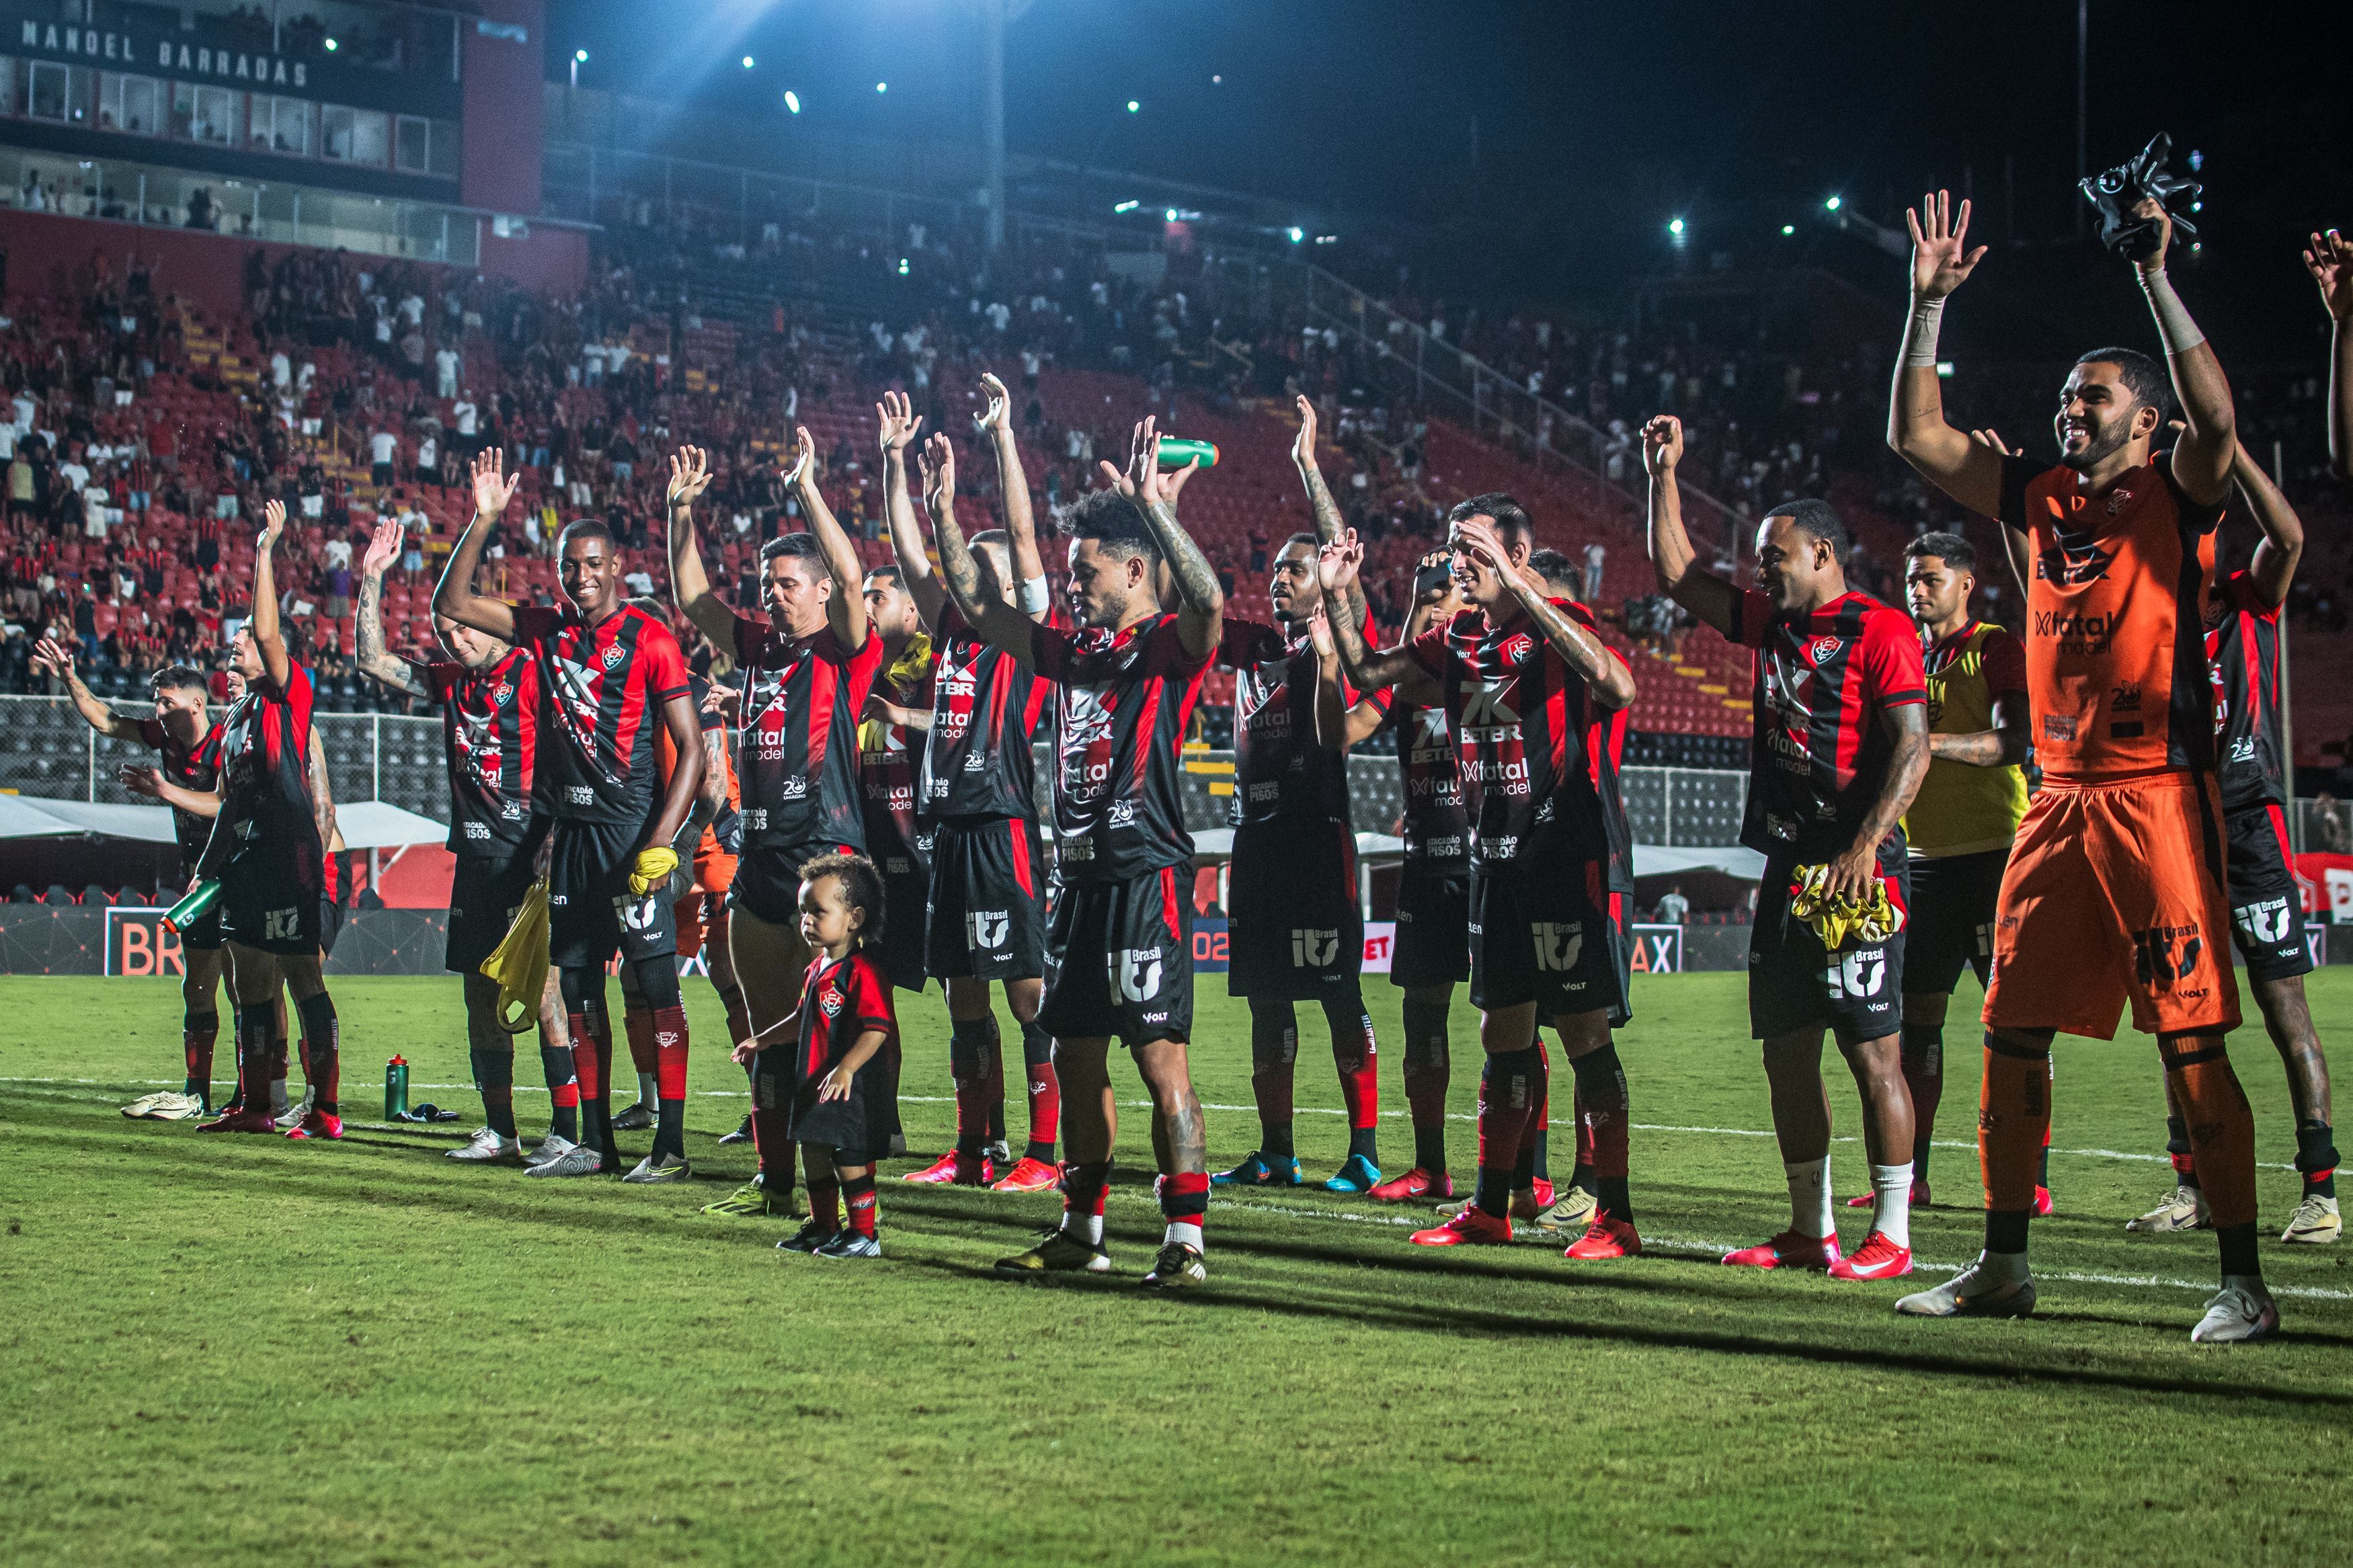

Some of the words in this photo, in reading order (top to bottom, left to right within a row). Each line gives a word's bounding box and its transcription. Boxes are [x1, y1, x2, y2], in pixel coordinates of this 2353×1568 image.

[22, 20, 134, 63] MANOEL
[159, 40, 307, 87] BARRADAS
[1457, 649, 1471, 659] VOLT
[745, 747, 785, 760] model
[1479, 757, 1529, 782] fatal
[1776, 757, 1810, 776] model
[1484, 780, 1531, 796] model
[565, 793, 593, 806] PISOS
[1250, 789, 1279, 802] PISOS
[1426, 835, 1461, 845] ATACADÃO
[1480, 835, 1517, 845] ATACADÃO
[1062, 845, 1096, 862] PISOS
[1427, 843, 1462, 857] PISOS
[1482, 843, 1517, 859] PISOS
[2261, 896, 2288, 913] Brasil
[985, 909, 1008, 921] Brasil
[1314, 928, 1337, 939] Brasil
[1555, 921, 1581, 934] Brasil
[2164, 922, 2199, 938] Brasil
[643, 931, 663, 941] VOLT
[993, 952, 1013, 962] VOLT
[1131, 946, 1162, 962] Brasil
[1856, 948, 1884, 962] Brasil
[1562, 981, 1587, 991] VOLT
[2178, 987, 2208, 999] VOLT
[1867, 1002, 1889, 1012] VOLT
[1142, 1012, 1168, 1024] VOLT
[1361, 1014, 1377, 1054] UniBARTER
